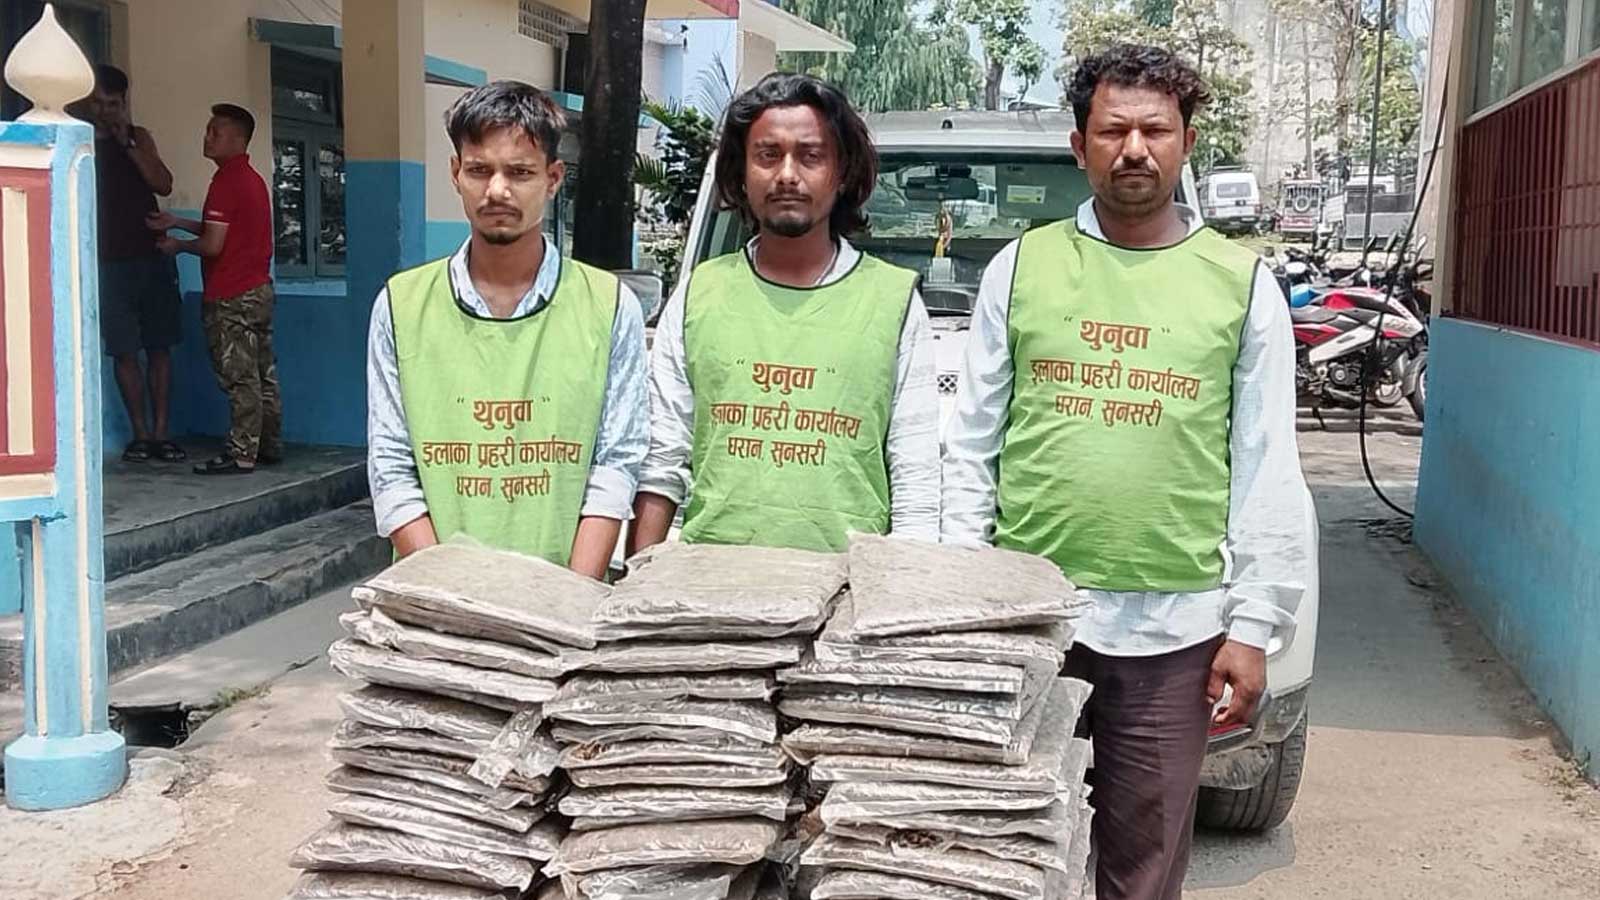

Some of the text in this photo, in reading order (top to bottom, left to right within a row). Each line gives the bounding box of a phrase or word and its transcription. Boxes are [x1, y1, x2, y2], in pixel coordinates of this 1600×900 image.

[1080, 320, 1152, 353] थुनुवा
[752, 362, 817, 395] थुनुवा
[1030, 359, 1202, 400] इलाका प्रहरी कार्यालय
[473, 399, 533, 430] थुनुवा
[752, 400, 791, 431] प्रहरी
[794, 406, 862, 440] कार्यालय
[1101, 398, 1164, 427] सुनसरी
[422, 435, 582, 468] इलाका प्रहरी कार्यालय
[770, 438, 827, 468] सुनसरी
[500, 469, 552, 503] सुनसरी
